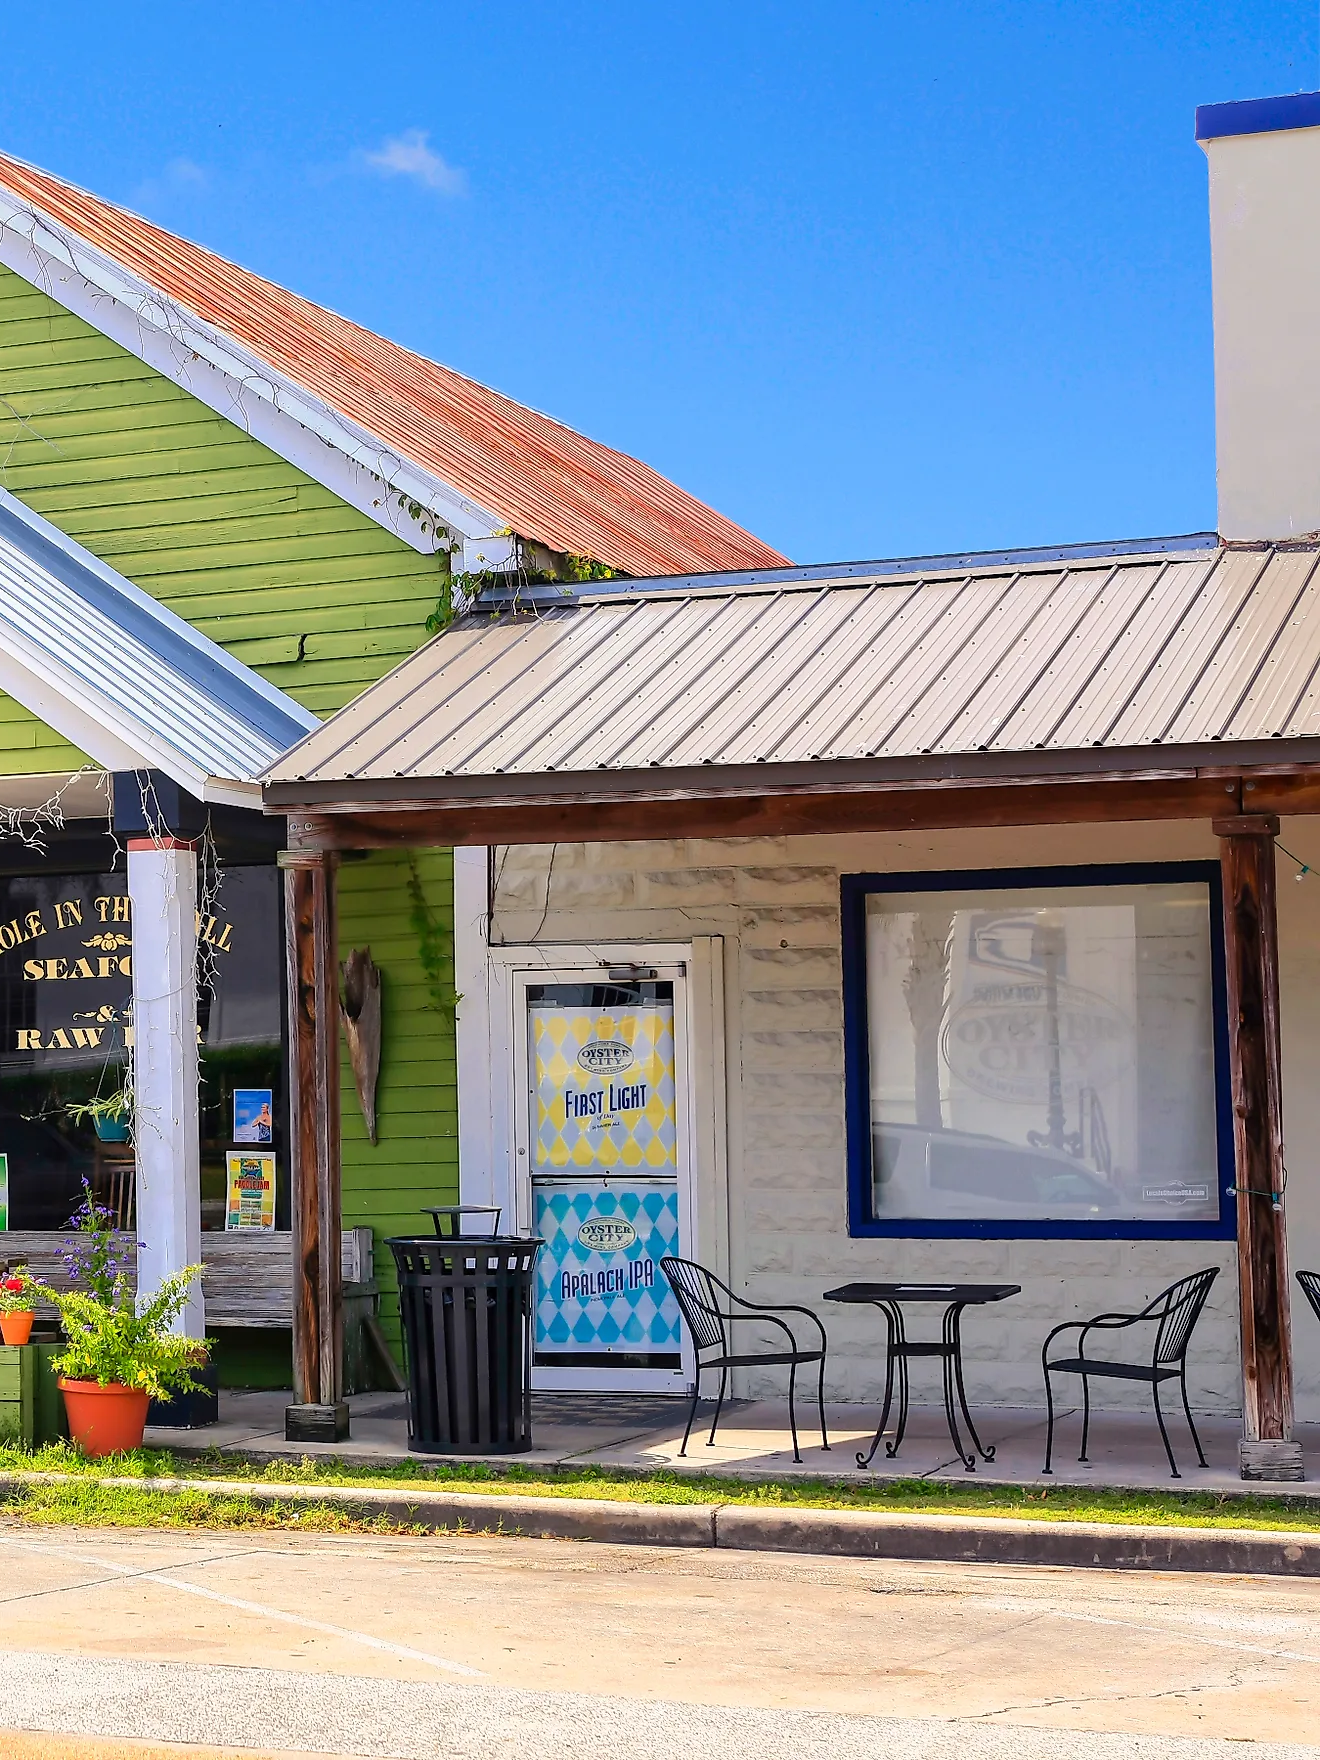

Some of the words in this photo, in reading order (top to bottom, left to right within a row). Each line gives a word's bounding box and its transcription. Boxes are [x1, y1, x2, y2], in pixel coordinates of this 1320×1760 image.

[53, 899, 83, 930] IN
[94, 896, 131, 923] TH
[16, 1027, 106, 1050] RAW
[581, 1048, 630, 1058] OYSTER
[588, 1057, 623, 1066] CITY
[565, 1090, 604, 1119] FIRST
[609, 1083, 647, 1112] LIGHT
[581, 1224, 631, 1235] OYSTER
[588, 1233, 624, 1242] CITY
[561, 1268, 624, 1299] APALACH
[629, 1258, 654, 1290] IPA
